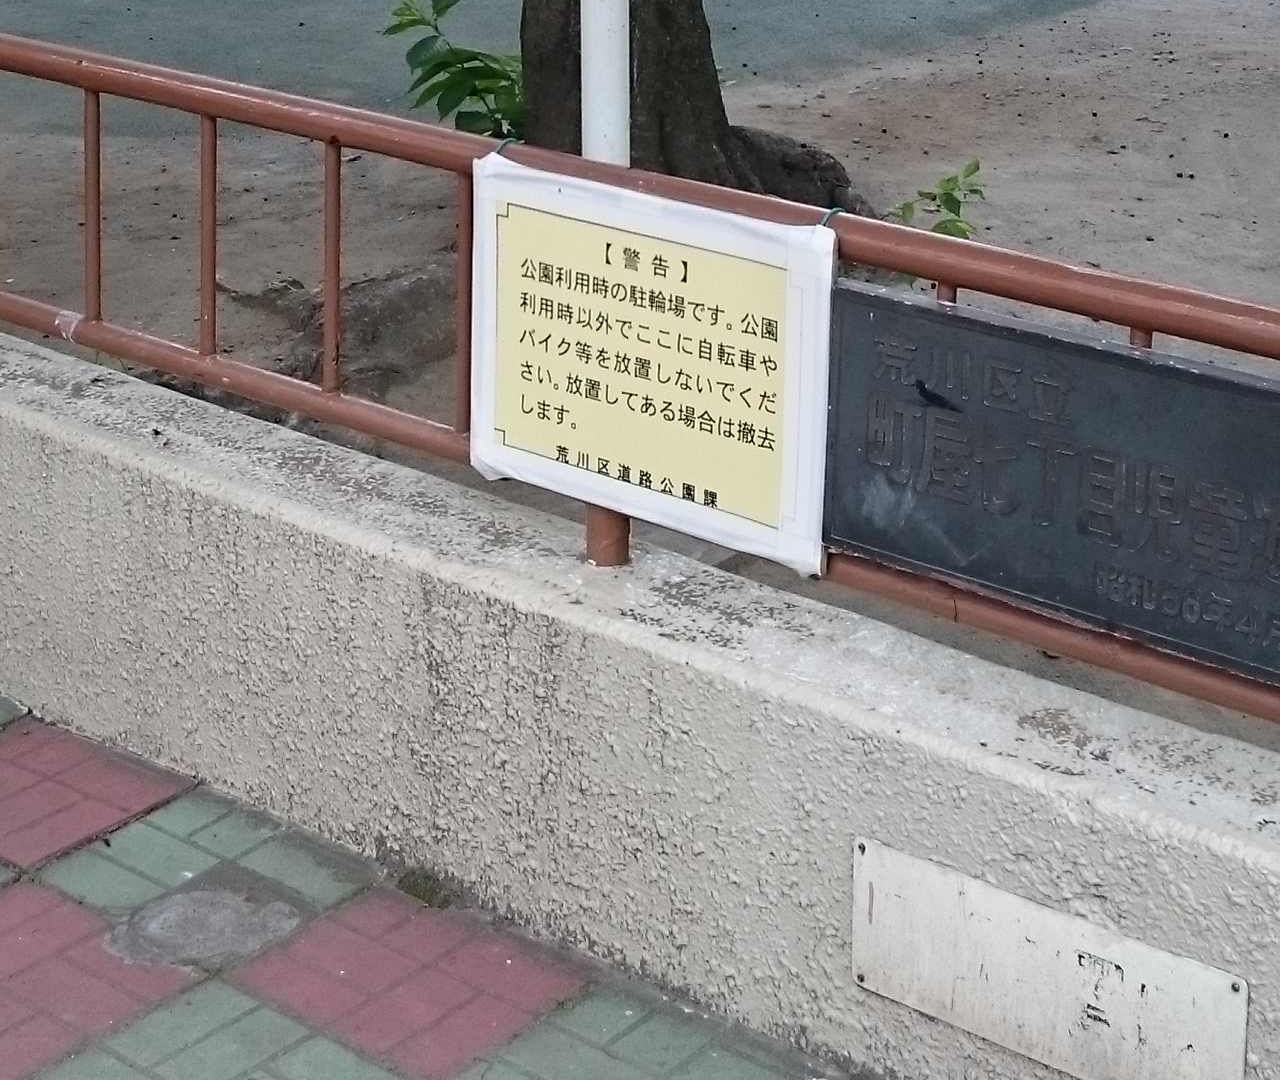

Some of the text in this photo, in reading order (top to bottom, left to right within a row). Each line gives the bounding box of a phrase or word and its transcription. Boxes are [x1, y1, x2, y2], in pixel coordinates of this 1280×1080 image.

[520, 257, 778, 343] 公園利用時の駐輪場です。公園
[520, 291, 778, 377] 利用時以外でここに自転車や
[519, 328, 777, 415] バイク等を放置しないでくだ
[520, 360, 776, 452] さい。放置してある場合は撤去
[521, 393, 578, 430] します。
[555, 444, 718, 509] 荒川区道路公園課
